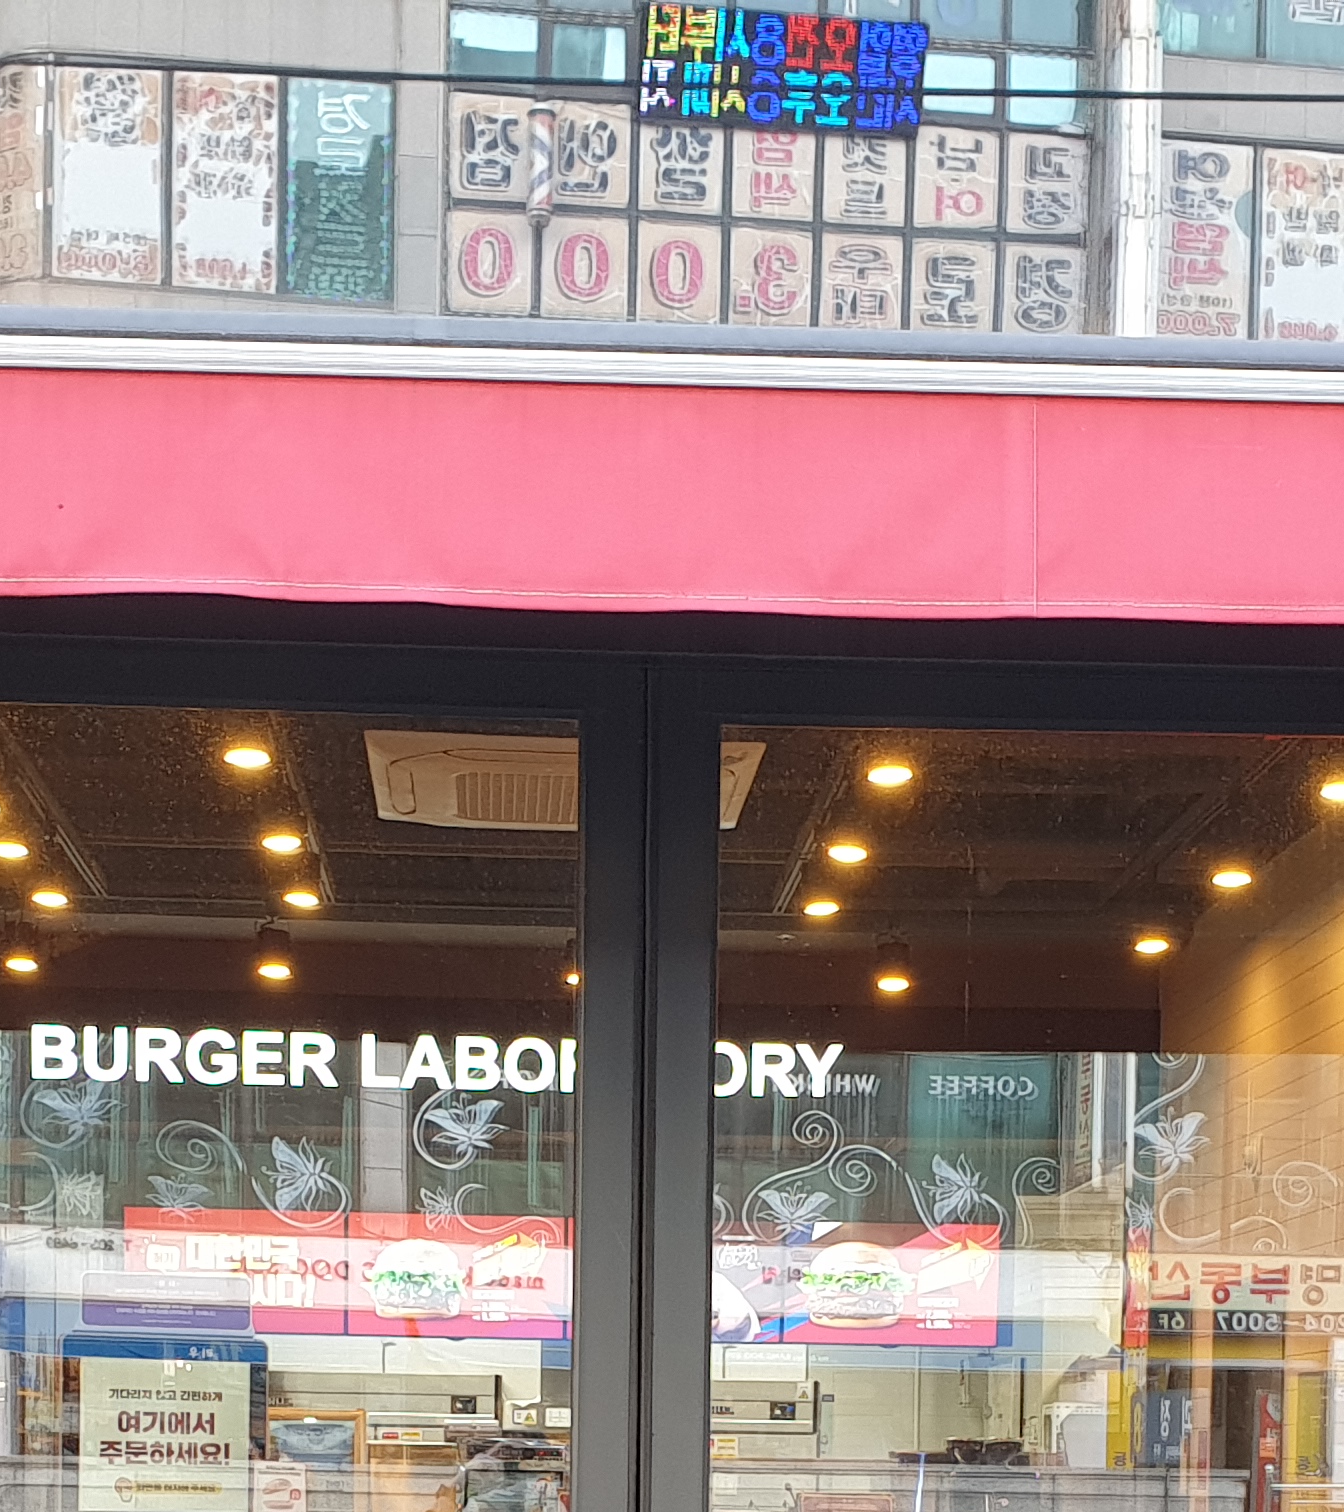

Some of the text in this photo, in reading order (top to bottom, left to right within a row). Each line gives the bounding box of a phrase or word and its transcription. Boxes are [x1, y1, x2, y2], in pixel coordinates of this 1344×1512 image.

[30, 1024, 338, 1088] BURGER
[118, 1410, 216, 1435] 여기에서
[100, 1440, 230, 1466] 주문하세요!
